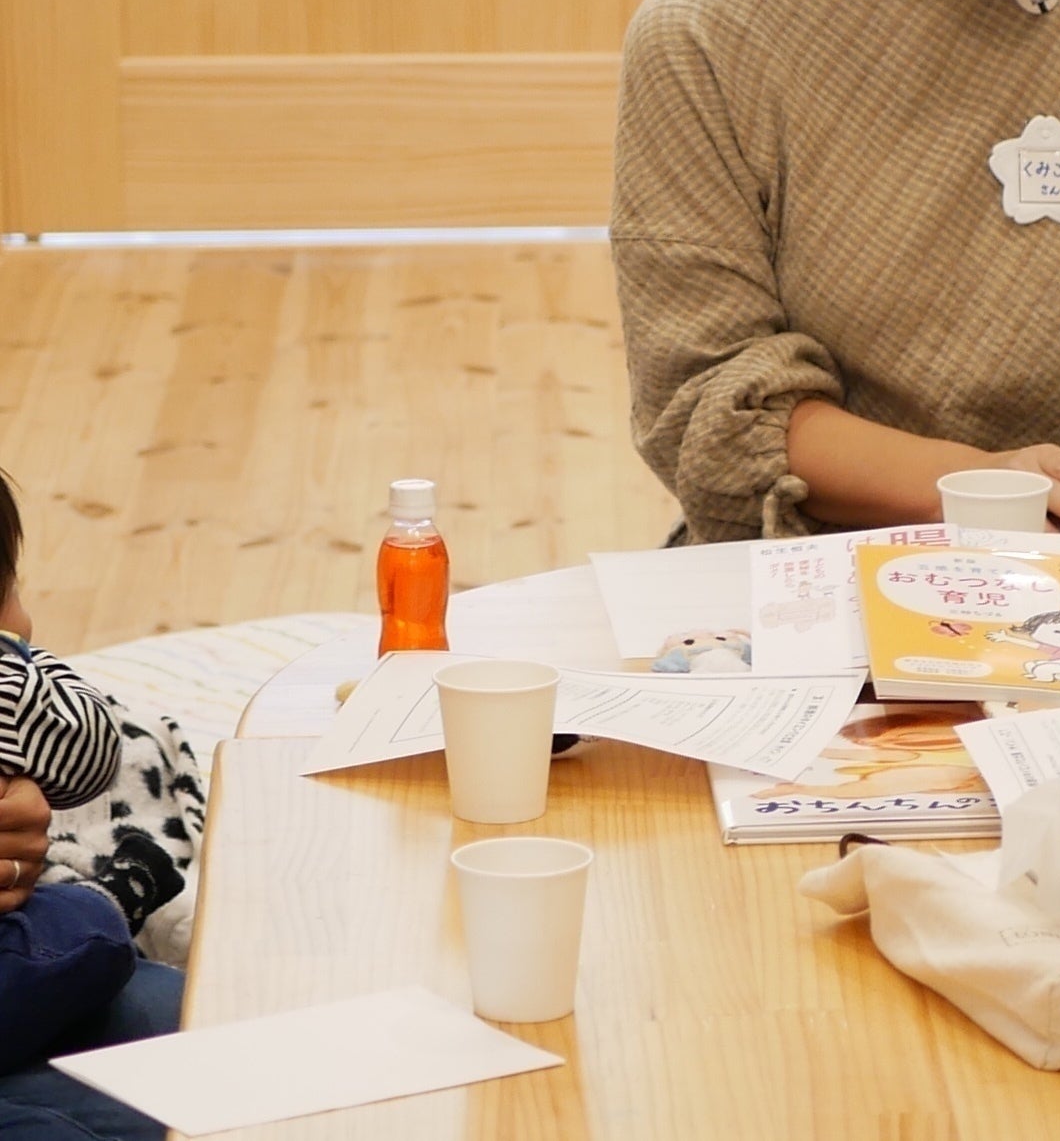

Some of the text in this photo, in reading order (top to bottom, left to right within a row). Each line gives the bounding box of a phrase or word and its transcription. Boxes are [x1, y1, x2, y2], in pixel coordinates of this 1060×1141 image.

[1040, 184, 1060, 196] さん
[888, 571, 1054, 594] おむつなし
[936, 590, 1010, 608] 育児
